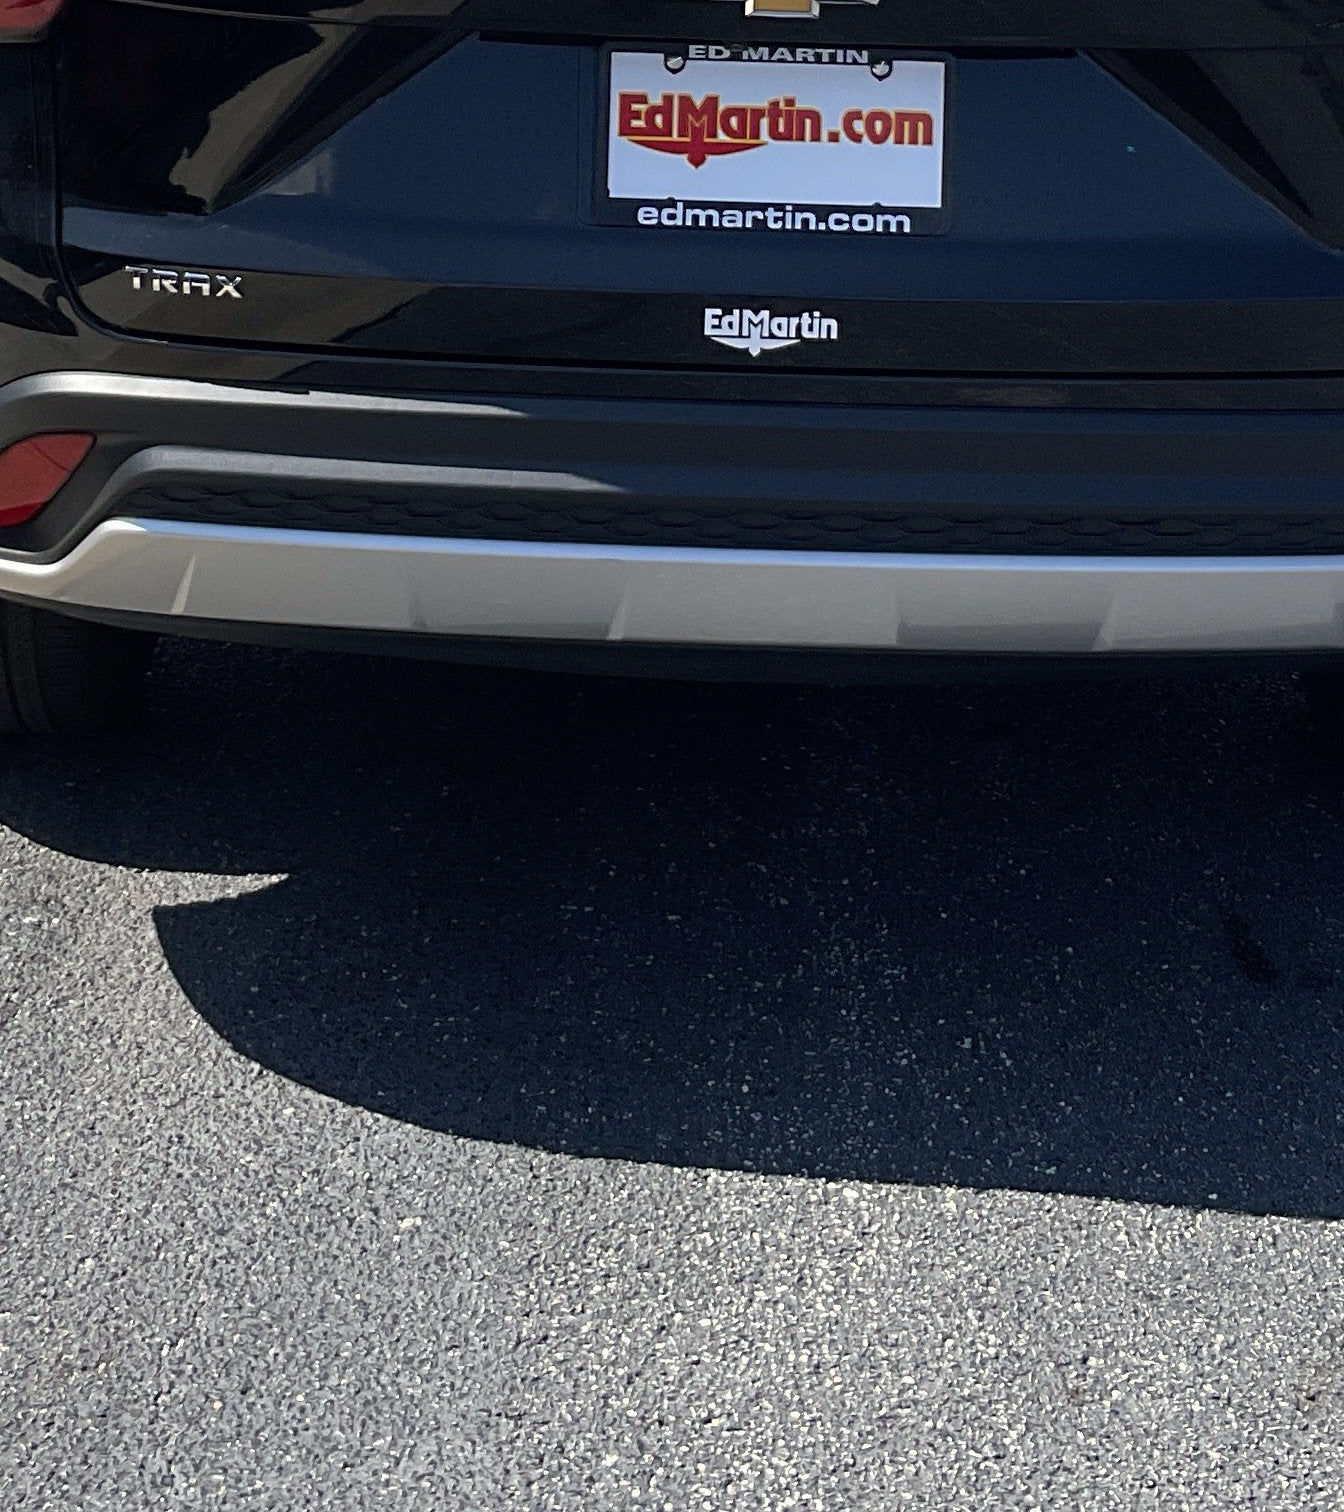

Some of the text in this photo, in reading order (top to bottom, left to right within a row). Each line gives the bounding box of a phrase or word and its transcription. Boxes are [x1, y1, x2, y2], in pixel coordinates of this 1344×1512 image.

[688, 44, 869, 65] ED MARTIN
[617, 91, 934, 150] EdMartin.com
[637, 201, 911, 234] edmartin.com
[123, 264, 244, 299] TRAX
[703, 307, 838, 343] EdMartin
